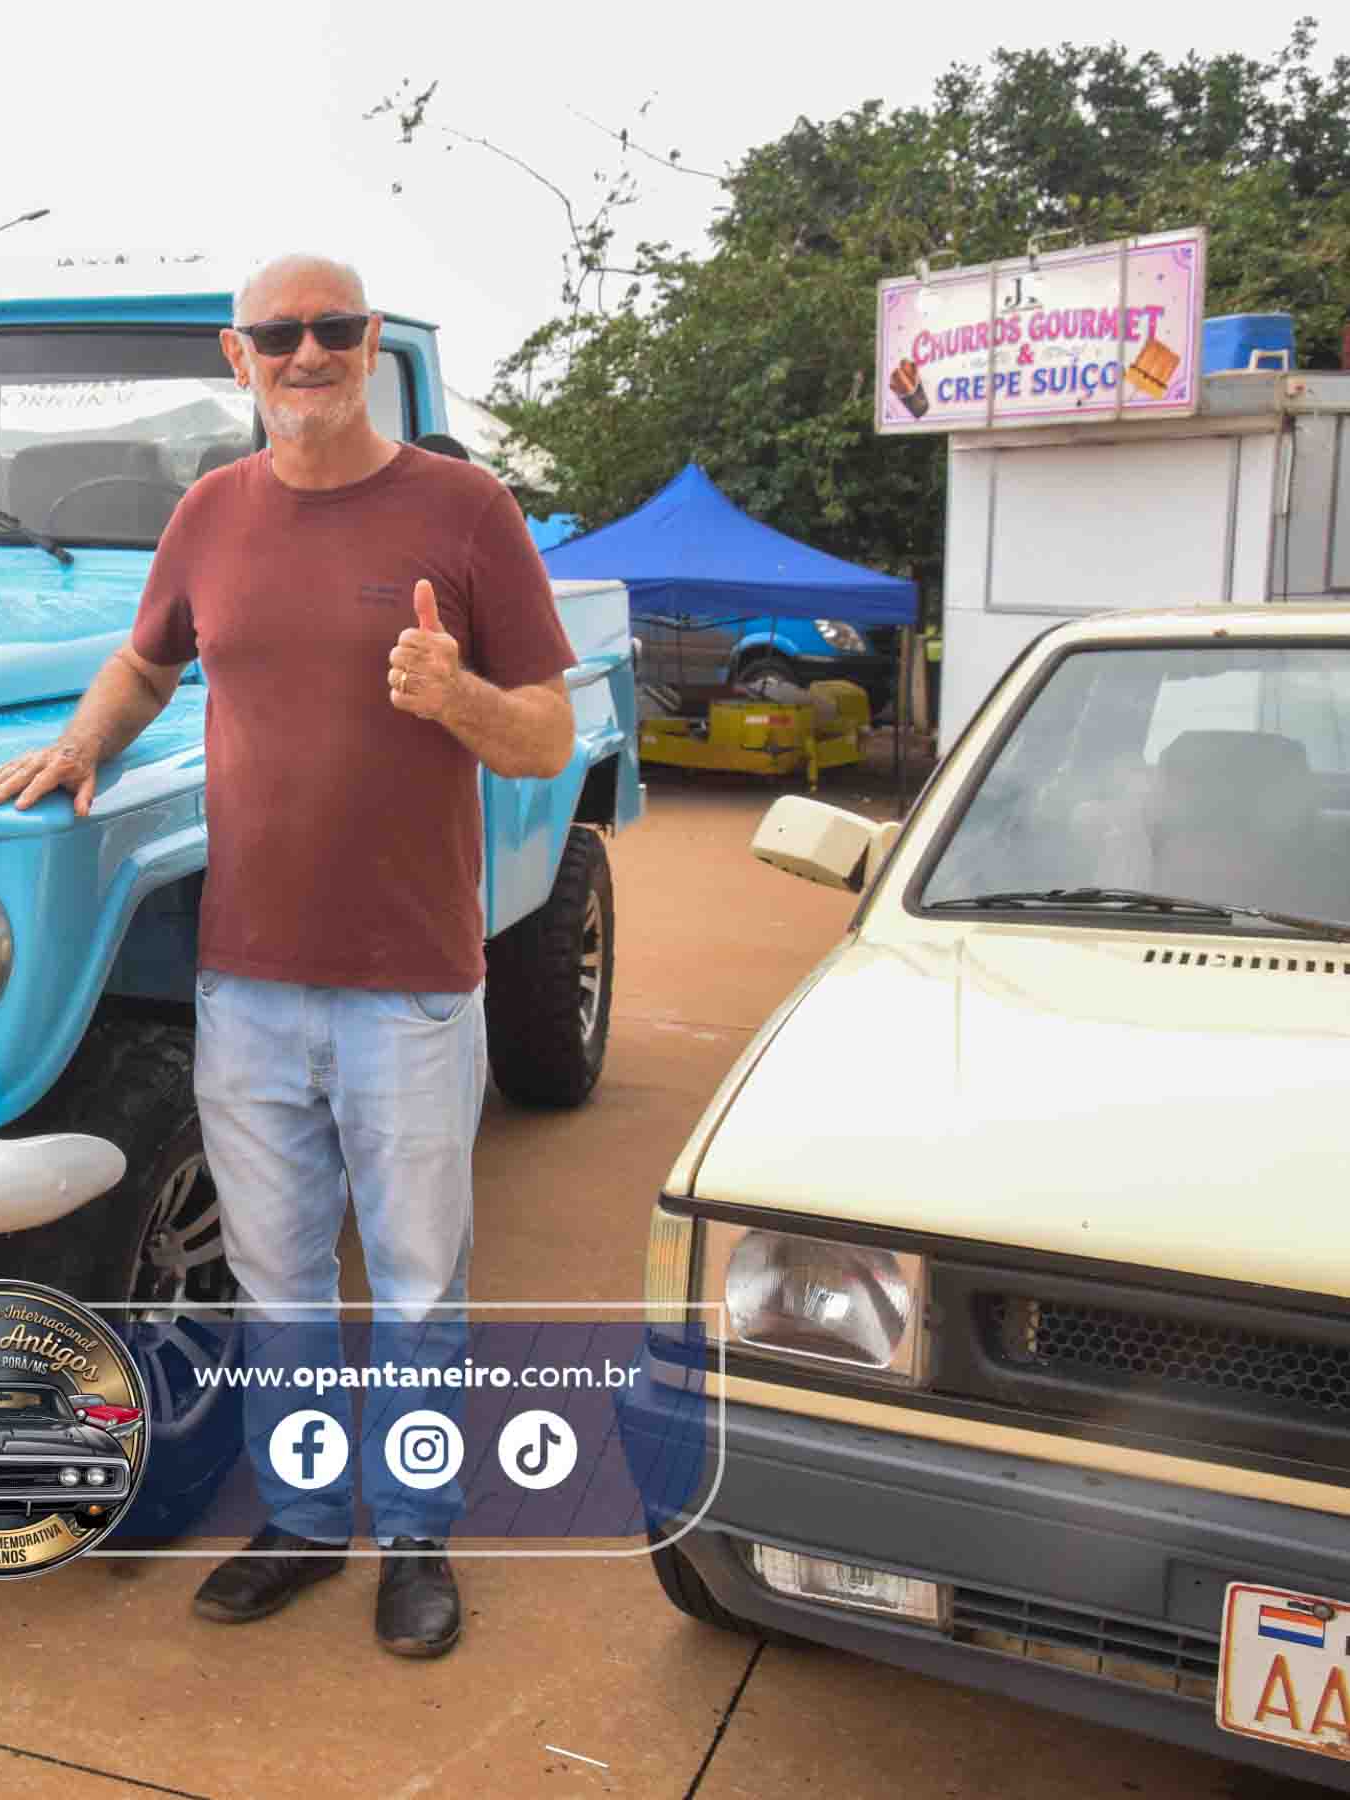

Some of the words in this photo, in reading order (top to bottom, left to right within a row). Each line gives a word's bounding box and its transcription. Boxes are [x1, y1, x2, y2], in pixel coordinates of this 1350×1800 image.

[912, 314, 1022, 368] CHURROS
[1028, 304, 1165, 344] GOURMET
[1017, 343, 1035, 366] &
[937, 368, 1021, 403] CREPE
